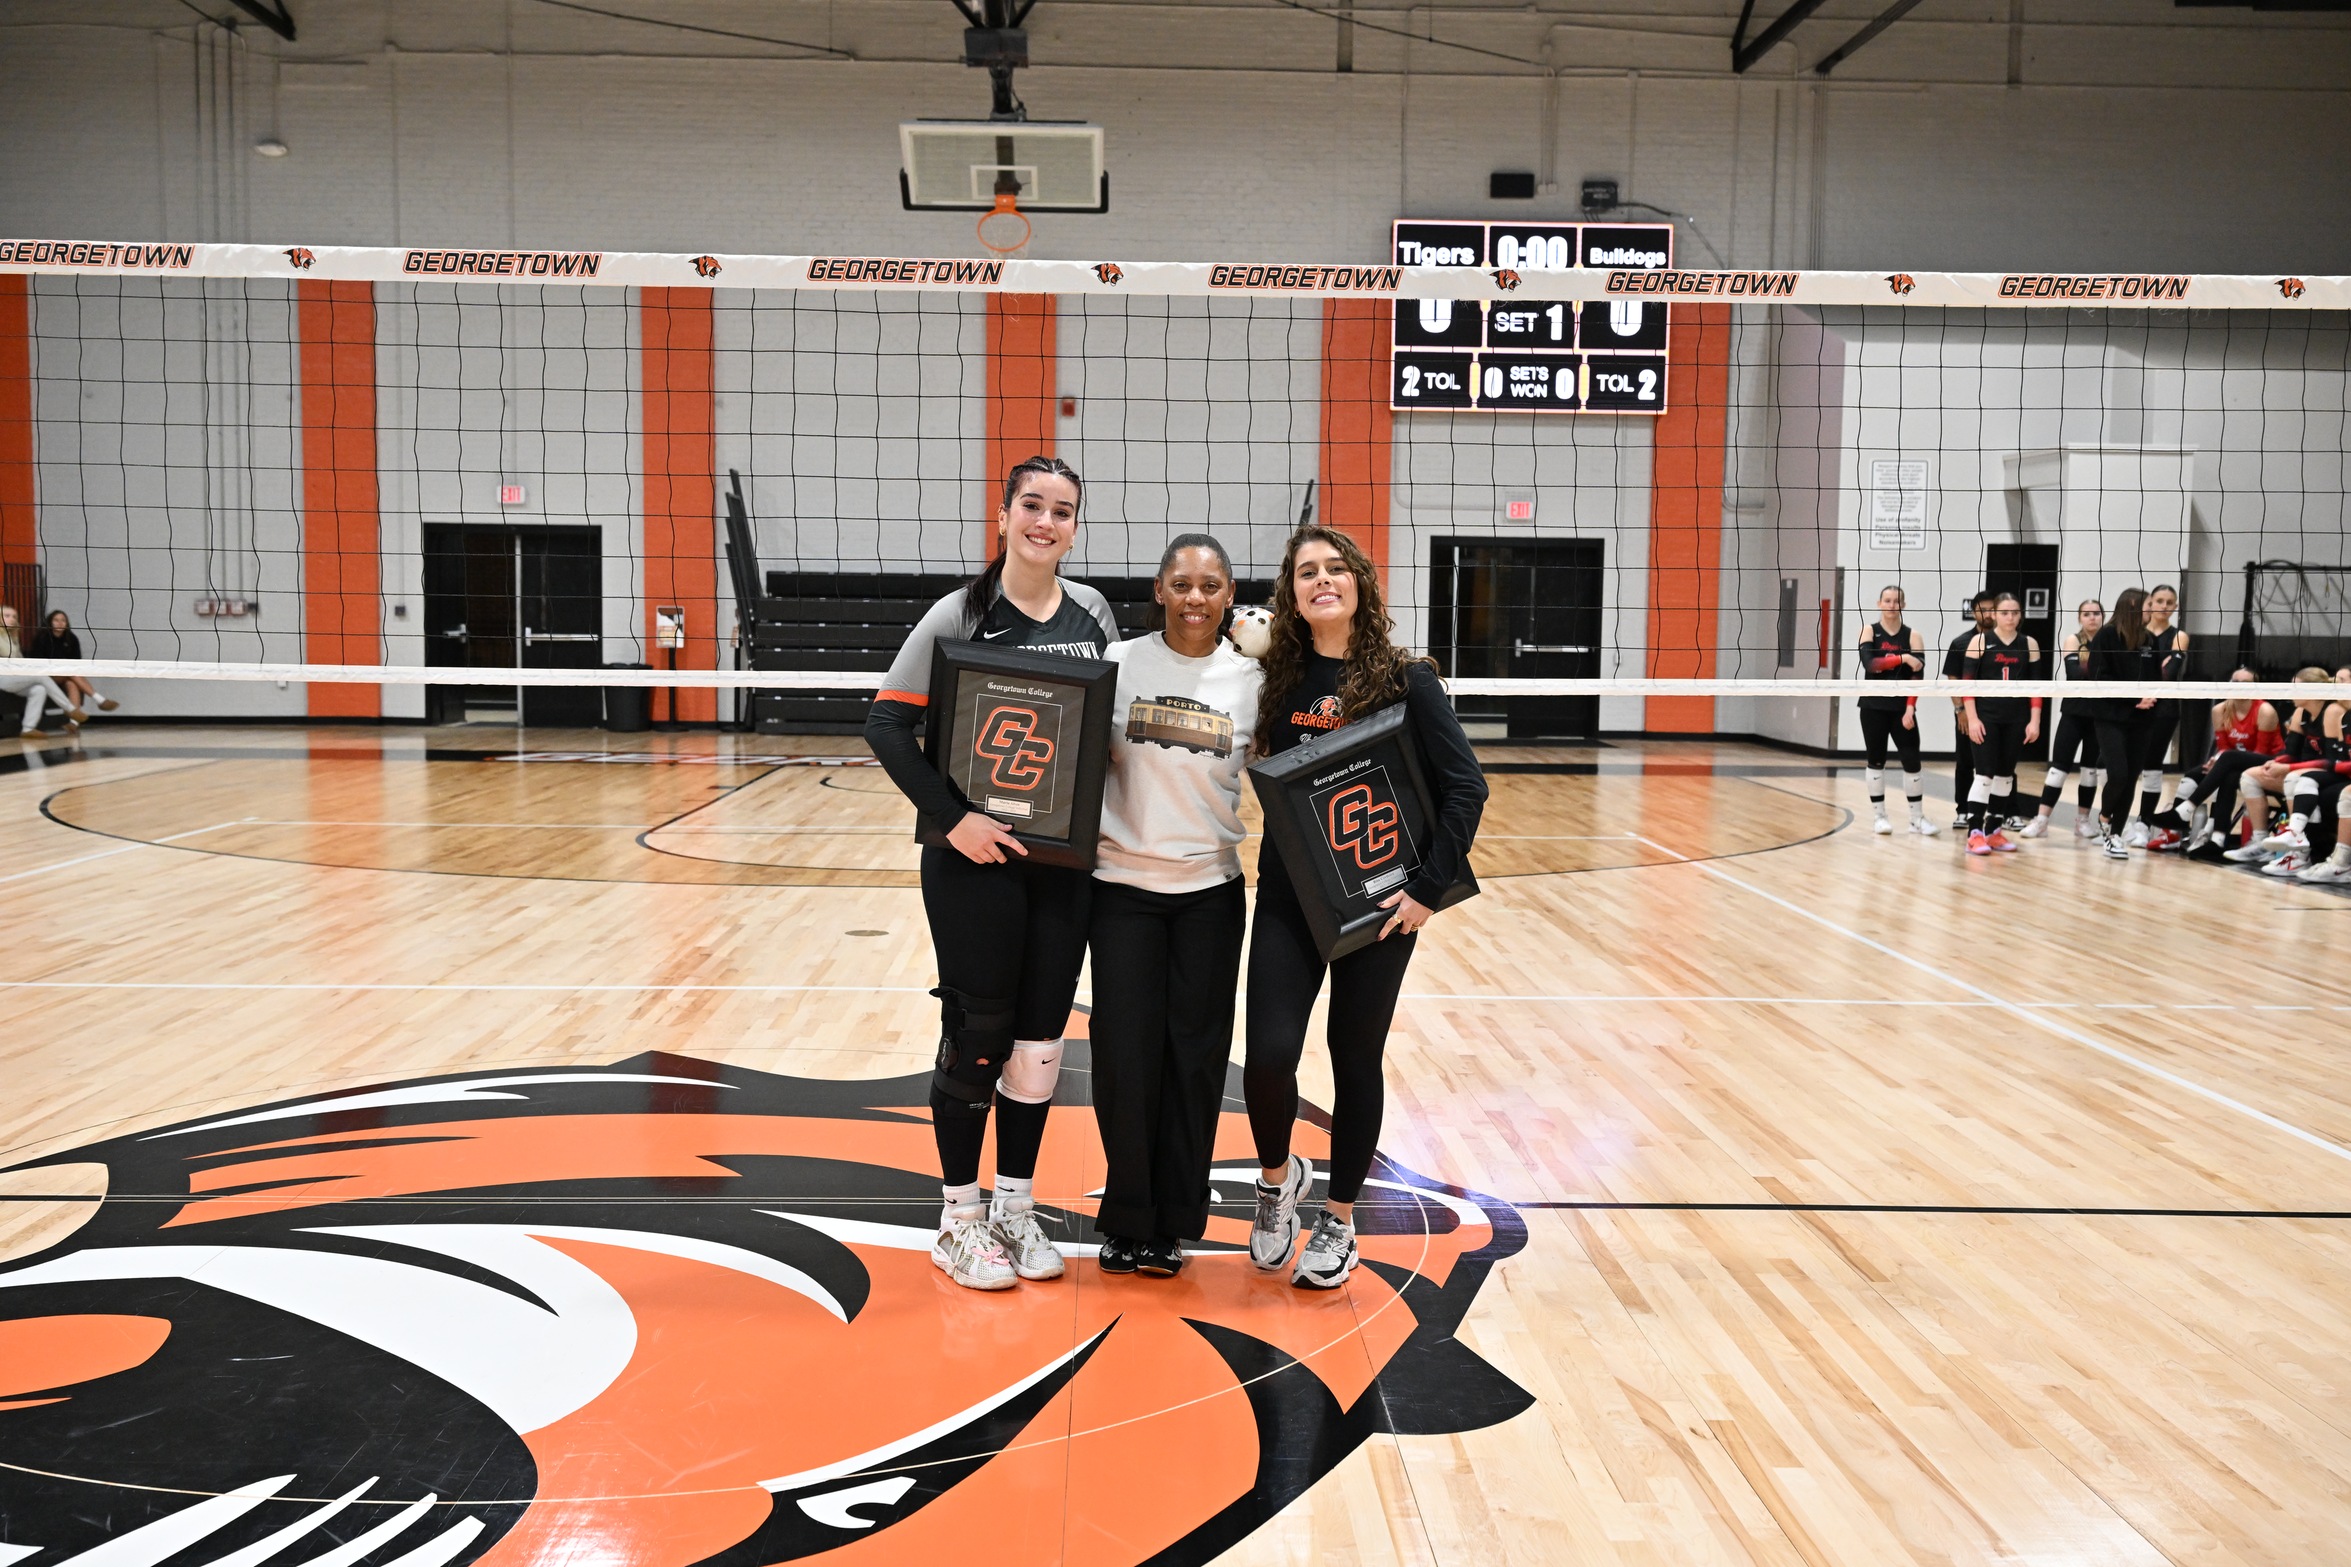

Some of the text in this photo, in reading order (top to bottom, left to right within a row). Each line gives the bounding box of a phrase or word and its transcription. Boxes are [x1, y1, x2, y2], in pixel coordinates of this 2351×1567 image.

[0, 240, 195, 268] GEORGETOWN
[402, 250, 602, 277] GEORGETOWN
[1398, 241, 1475, 267] Tigers
[1497, 234, 1568, 268] 0:00
[1589, 247, 1667, 268] Bulldogs
[807, 257, 1005, 284] GEORGETOWN
[1208, 264, 1404, 291] GEORGETOWN
[1605, 270, 1800, 297] GEORGETOWN
[1998, 274, 2191, 300] GEORGETOWN
[1495, 304, 1564, 341] SET 1
[1401, 365, 1461, 397] 2 TOL
[1484, 366, 1575, 400] 0 SETS 0
[1510, 383, 1548, 398] WON
[1596, 369, 1657, 400] TOL 2
[1510, 502, 1530, 518] EXIT
[987, 681, 1054, 699] Georgetown College
[1166, 698, 1202, 711] PORTO
[975, 705, 1055, 791] GC
[1313, 758, 1372, 787] Georgetown College
[1328, 784, 1398, 870] GC
